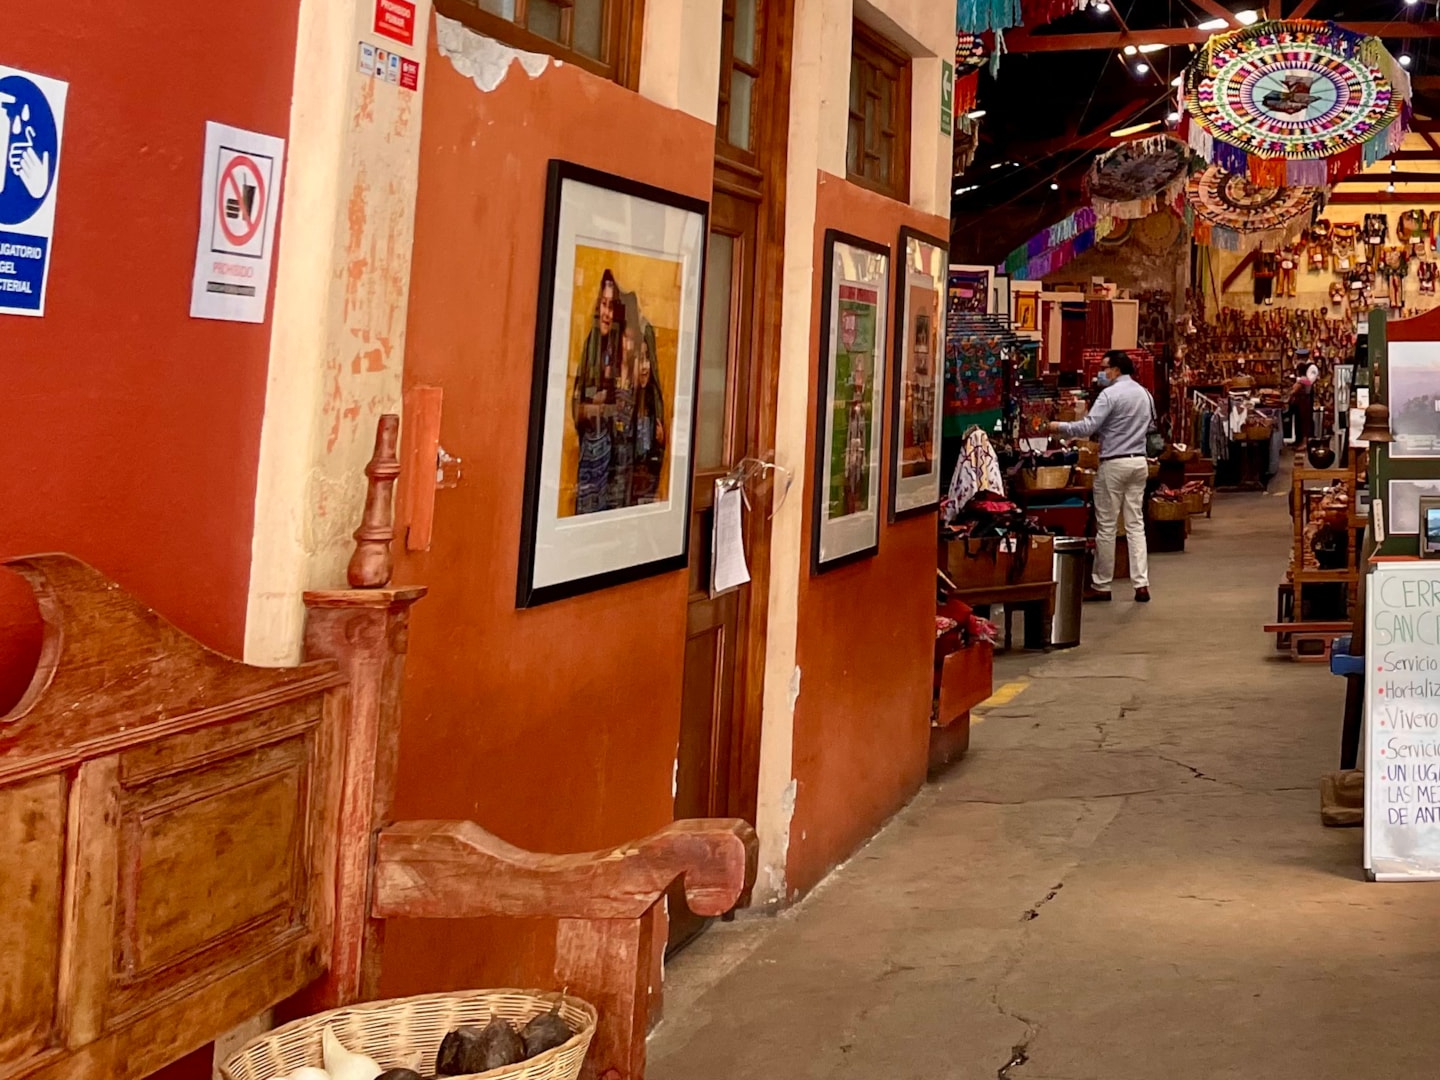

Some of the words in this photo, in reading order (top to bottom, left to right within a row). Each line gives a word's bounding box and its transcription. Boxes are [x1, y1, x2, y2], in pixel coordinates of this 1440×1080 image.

[0, 243, 42, 259] IGATORIO
[0, 261, 17, 274] GEL
[0, 278, 32, 294] TERIAL
[1384, 651, 1438, 672] Servicio
[1385, 707, 1438, 729] Vivero
[1387, 763, 1407, 782] UN
[1387, 784, 1411, 804] LAS
[1388, 807, 1408, 825] DE
